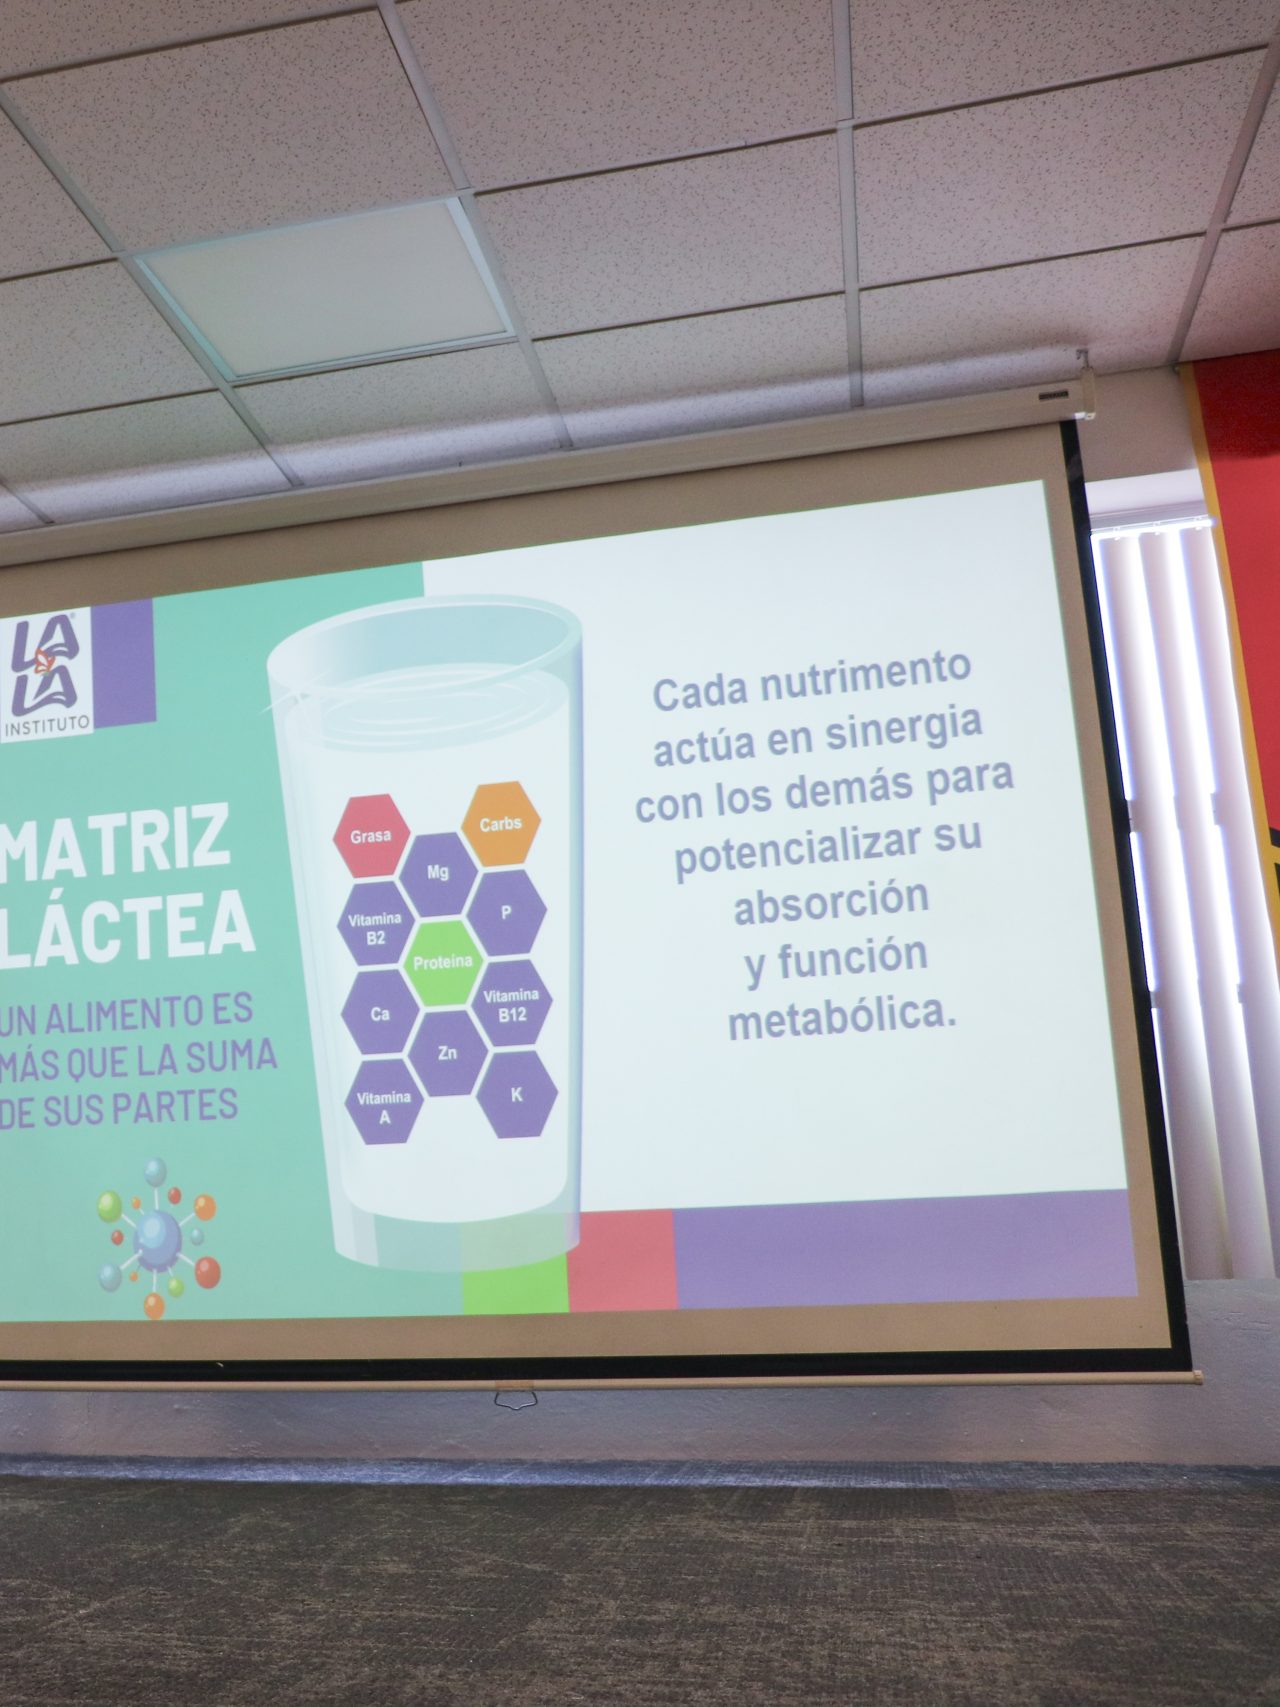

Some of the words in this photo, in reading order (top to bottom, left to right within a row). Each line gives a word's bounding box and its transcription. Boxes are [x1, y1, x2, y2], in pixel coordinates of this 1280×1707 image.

[652, 672, 748, 712] Cada
[761, 650, 972, 701] nutrimento
[5, 714, 90, 737] INSTITUTO
[653, 728, 755, 767] actúa
[767, 726, 813, 756] en
[825, 703, 983, 750] sinergia
[635, 791, 703, 823] con
[716, 782, 772, 816] los
[785, 767, 913, 809] demás
[926, 761, 1014, 806] para
[480, 817, 522, 831] Carbs
[350, 829, 392, 844] Grasa
[674, 825, 922, 884] potencializar
[934, 822, 982, 852] su
[427, 865, 449, 881] Mg
[734, 879, 929, 926] absorción
[348, 912, 402, 927] Vitamina
[502, 906, 512, 919] P
[367, 931, 385, 945] B2
[744, 954, 766, 991] y
[778, 936, 928, 979] función
[483, 988, 539, 1003] Vitamina
[45, 994, 203, 1035] ALIMENTO
[213, 991, 253, 1025] ES
[370, 1008, 390, 1021] Ca
[498, 1008, 527, 1022] B12
[728, 994, 957, 1041] metabólica.
[68, 1047, 128, 1082] QUE
[137, 1044, 178, 1077] LA
[186, 1038, 278, 1074] SUMA
[438, 1046, 457, 1060] Zn
[357, 1091, 411, 1105] Vitamina
[511, 1088, 523, 1102] K
[44, 1094, 104, 1127] SUS
[113, 1088, 239, 1124] PARTES
[379, 1111, 391, 1124] A
